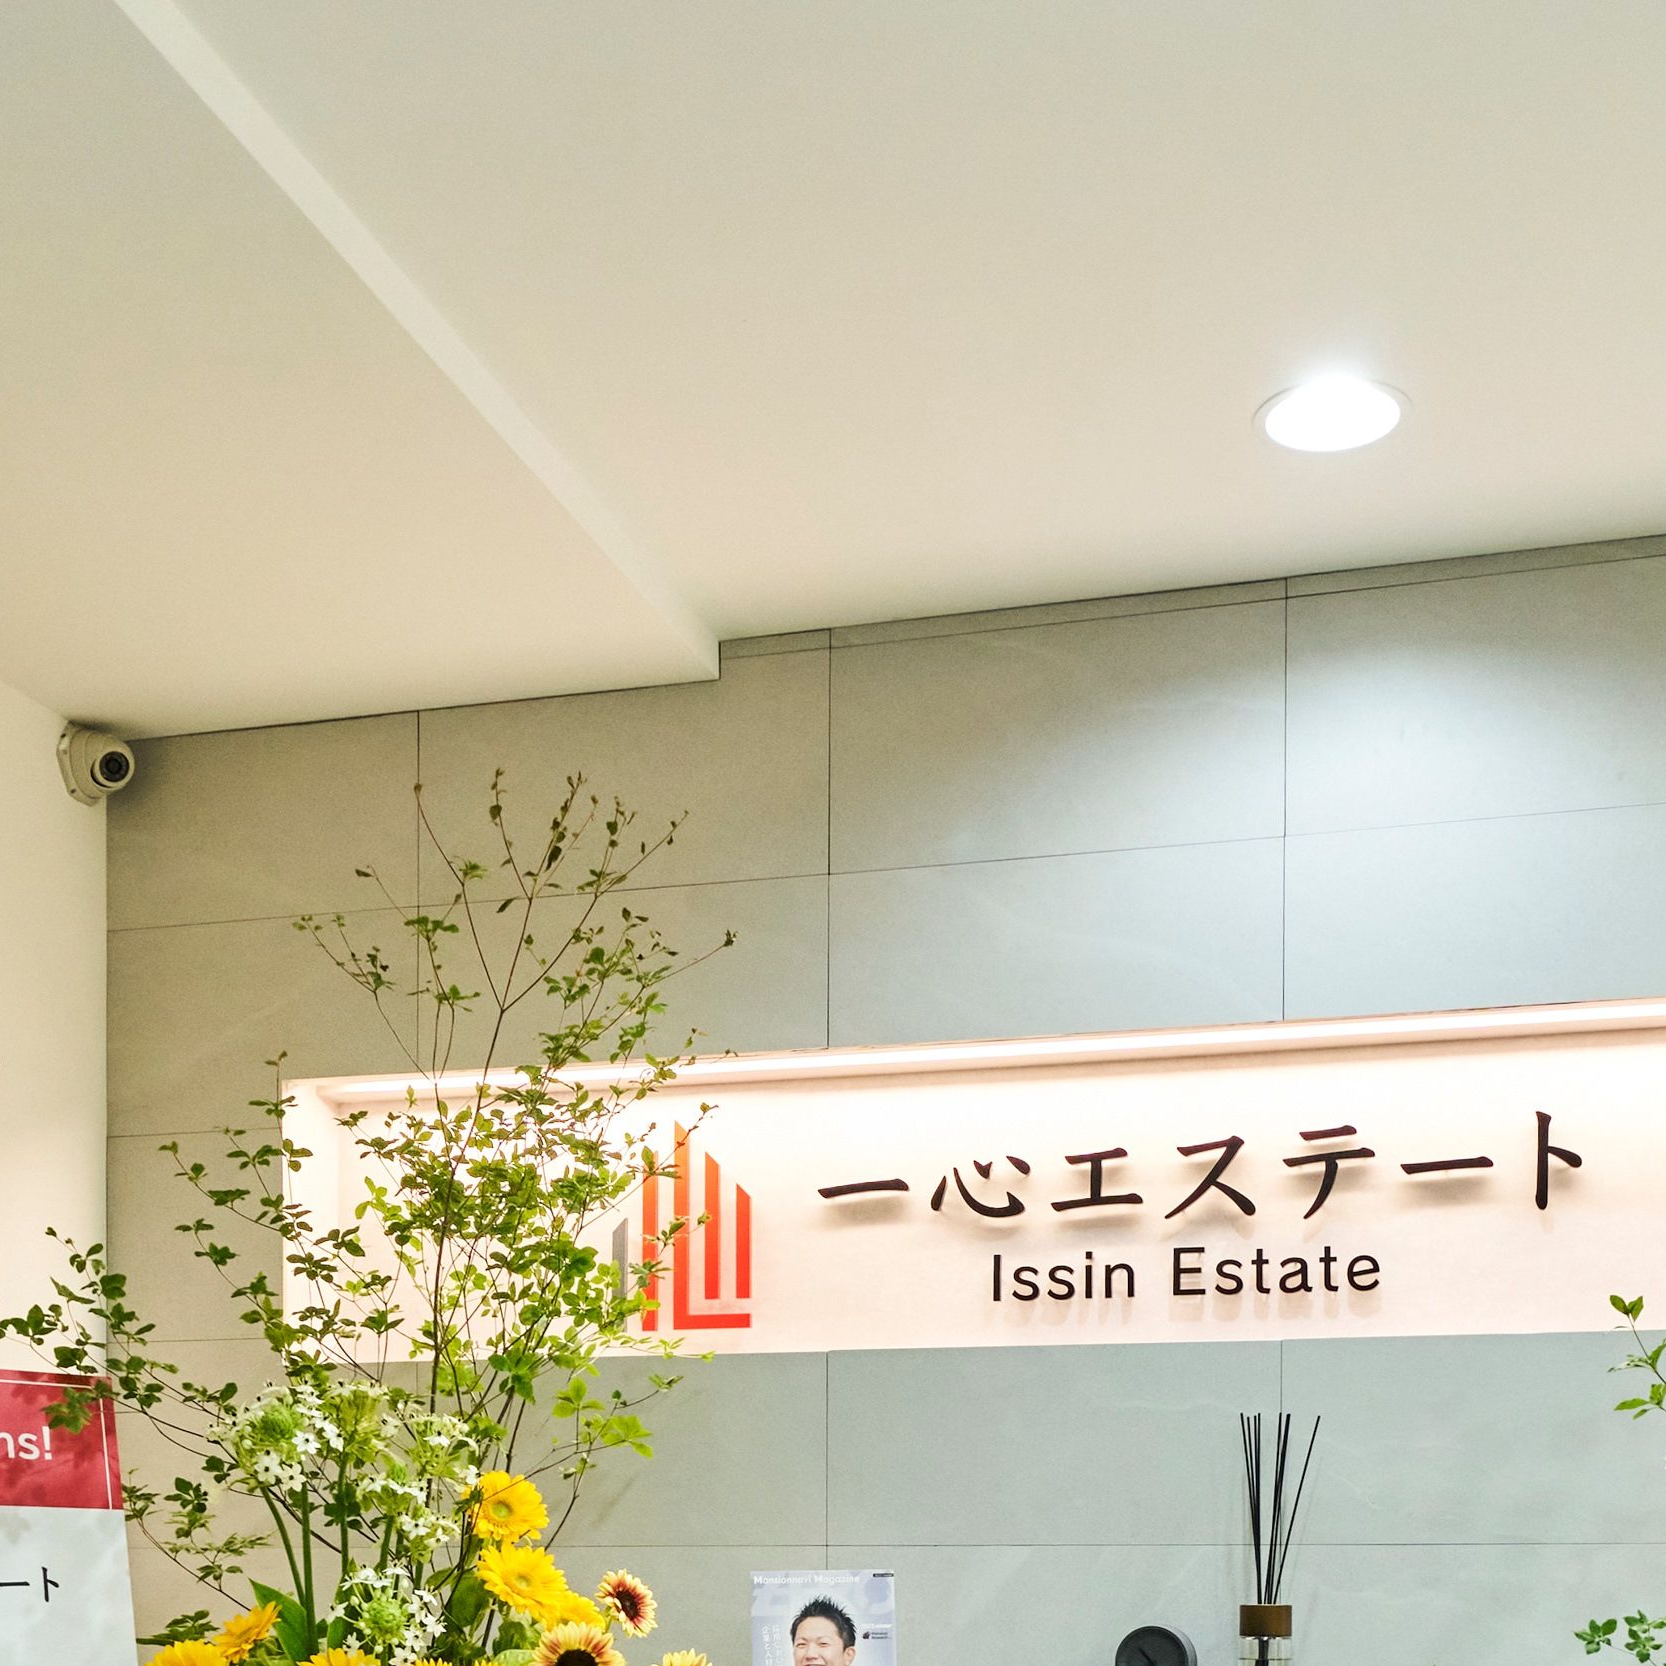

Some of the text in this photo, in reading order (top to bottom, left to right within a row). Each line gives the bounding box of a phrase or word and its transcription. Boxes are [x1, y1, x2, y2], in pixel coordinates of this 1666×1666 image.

[817, 1110, 1583, 1220] 一心エステート
[993, 1245, 1382, 1303] Issin Estate
